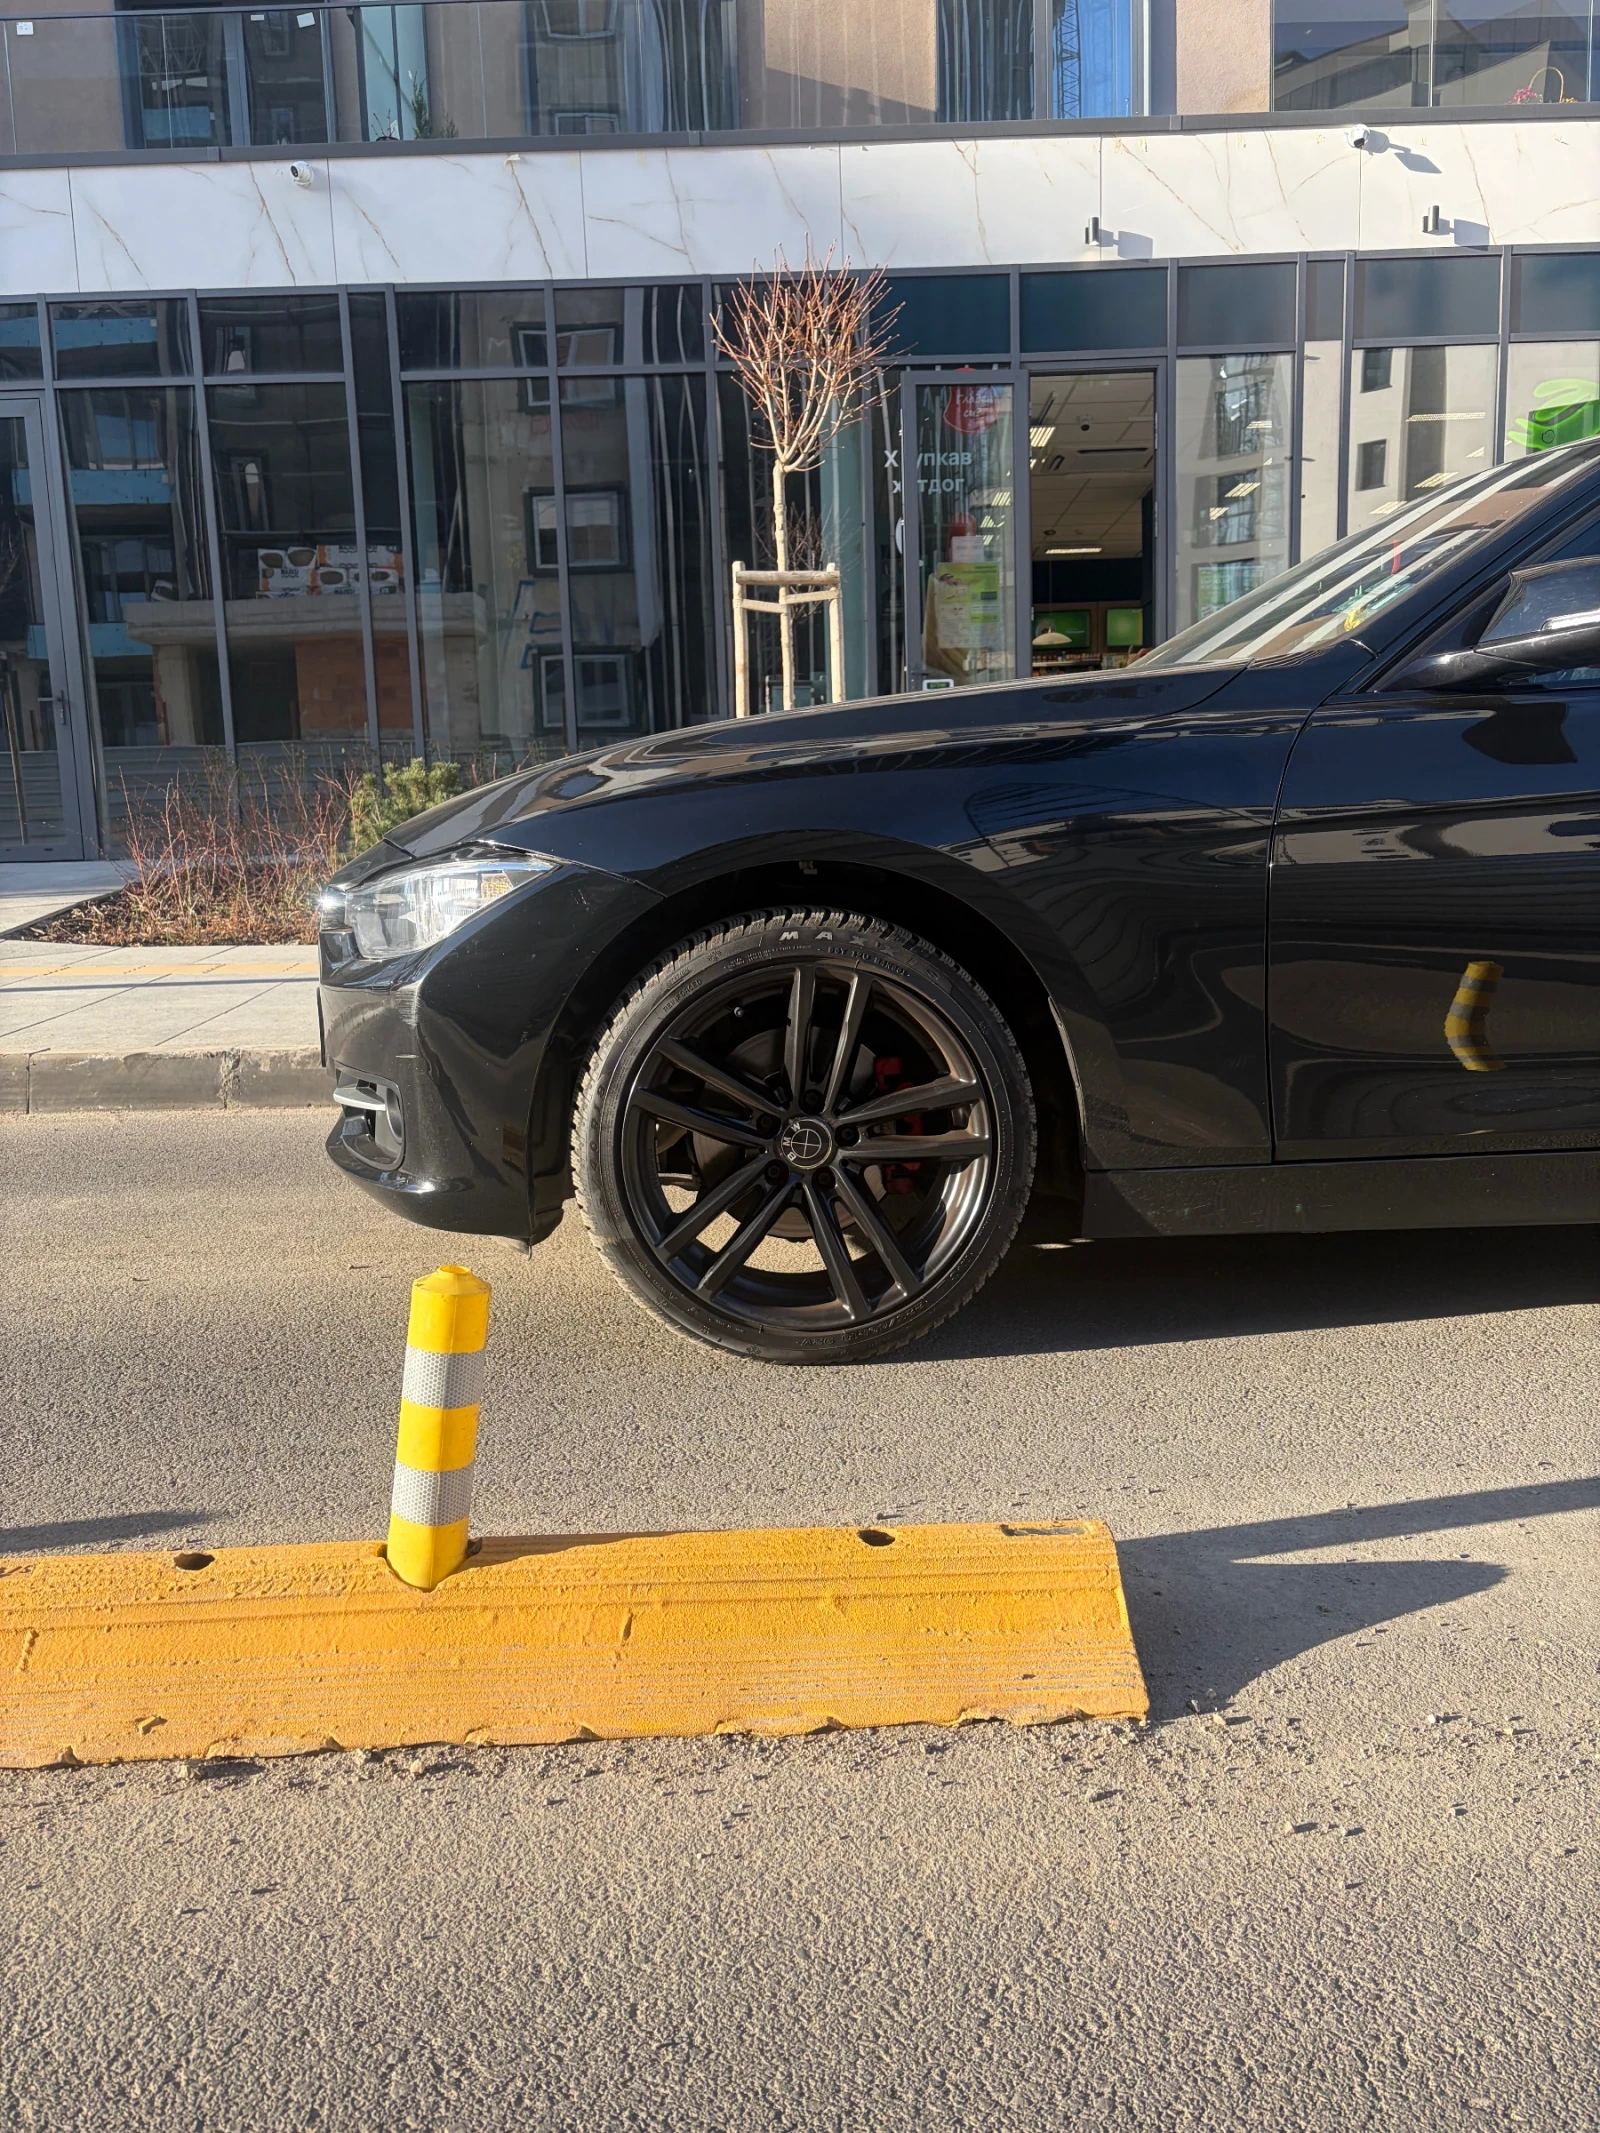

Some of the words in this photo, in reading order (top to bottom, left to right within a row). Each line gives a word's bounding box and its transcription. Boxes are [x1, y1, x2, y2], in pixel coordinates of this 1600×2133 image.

[884, 450, 972, 469] Хупкав
[892, 479, 965, 495] хтдог
[662, 978, 703, 1013] REINFORCED
[782, 1122, 801, 1161] BMW
